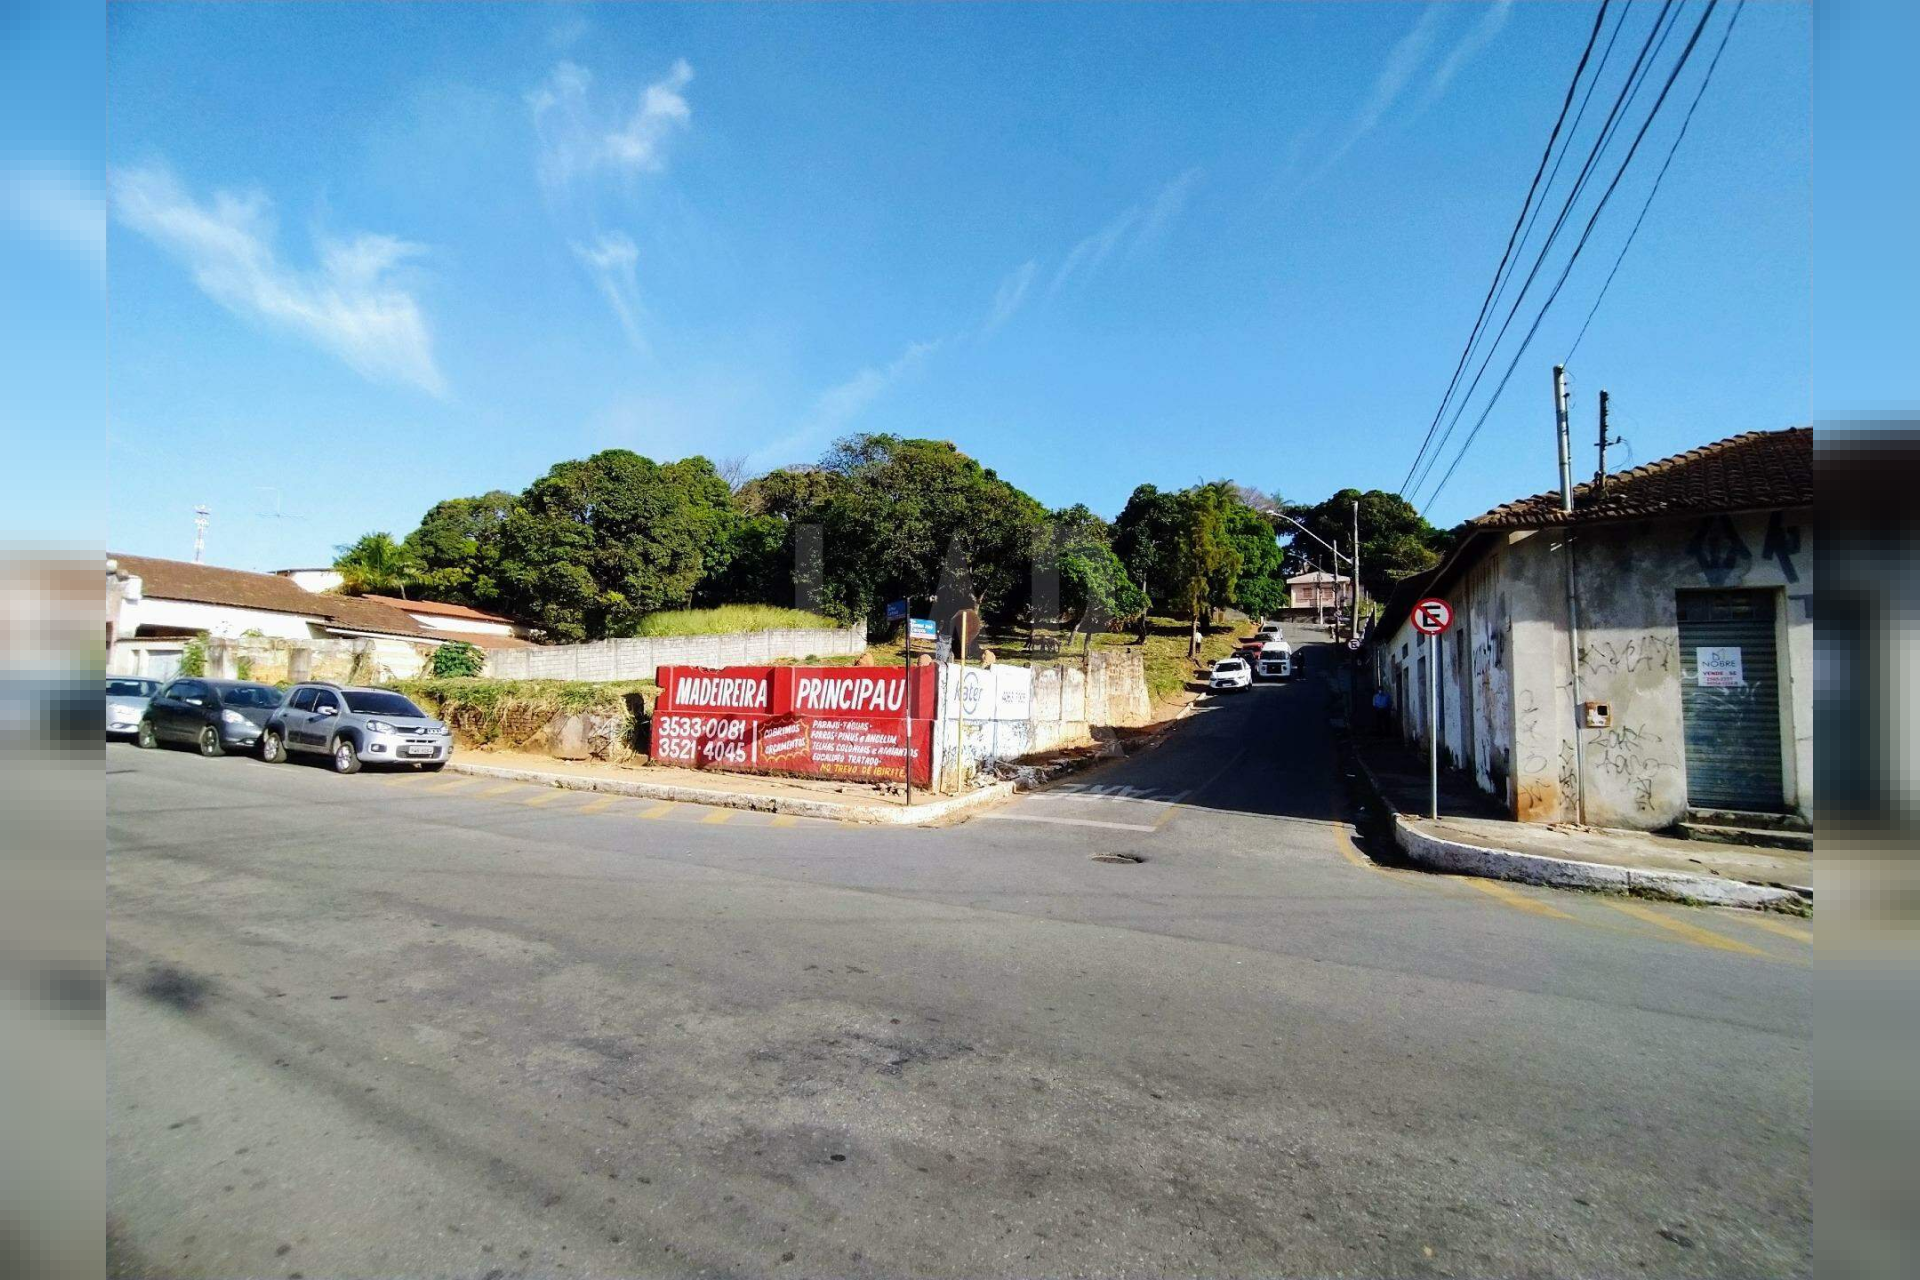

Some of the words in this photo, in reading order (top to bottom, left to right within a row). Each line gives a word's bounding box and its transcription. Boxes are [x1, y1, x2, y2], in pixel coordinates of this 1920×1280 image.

[1421, 605, 1441, 627] E
[1702, 660, 1736, 668] NOBRE
[675, 677, 768, 708] MADEIREIRA
[795, 678, 906, 711] PRINCIPAU
[763, 724, 801, 739] COBRIMOS
[838, 731, 860, 742] PINUS
[865, 733, 898, 745] ANGELIM
[812, 741, 835, 751] TELHAS
[820, 763, 831, 772] NO
[834, 764, 858, 774] TREVO
[861, 766, 873, 775] DE
